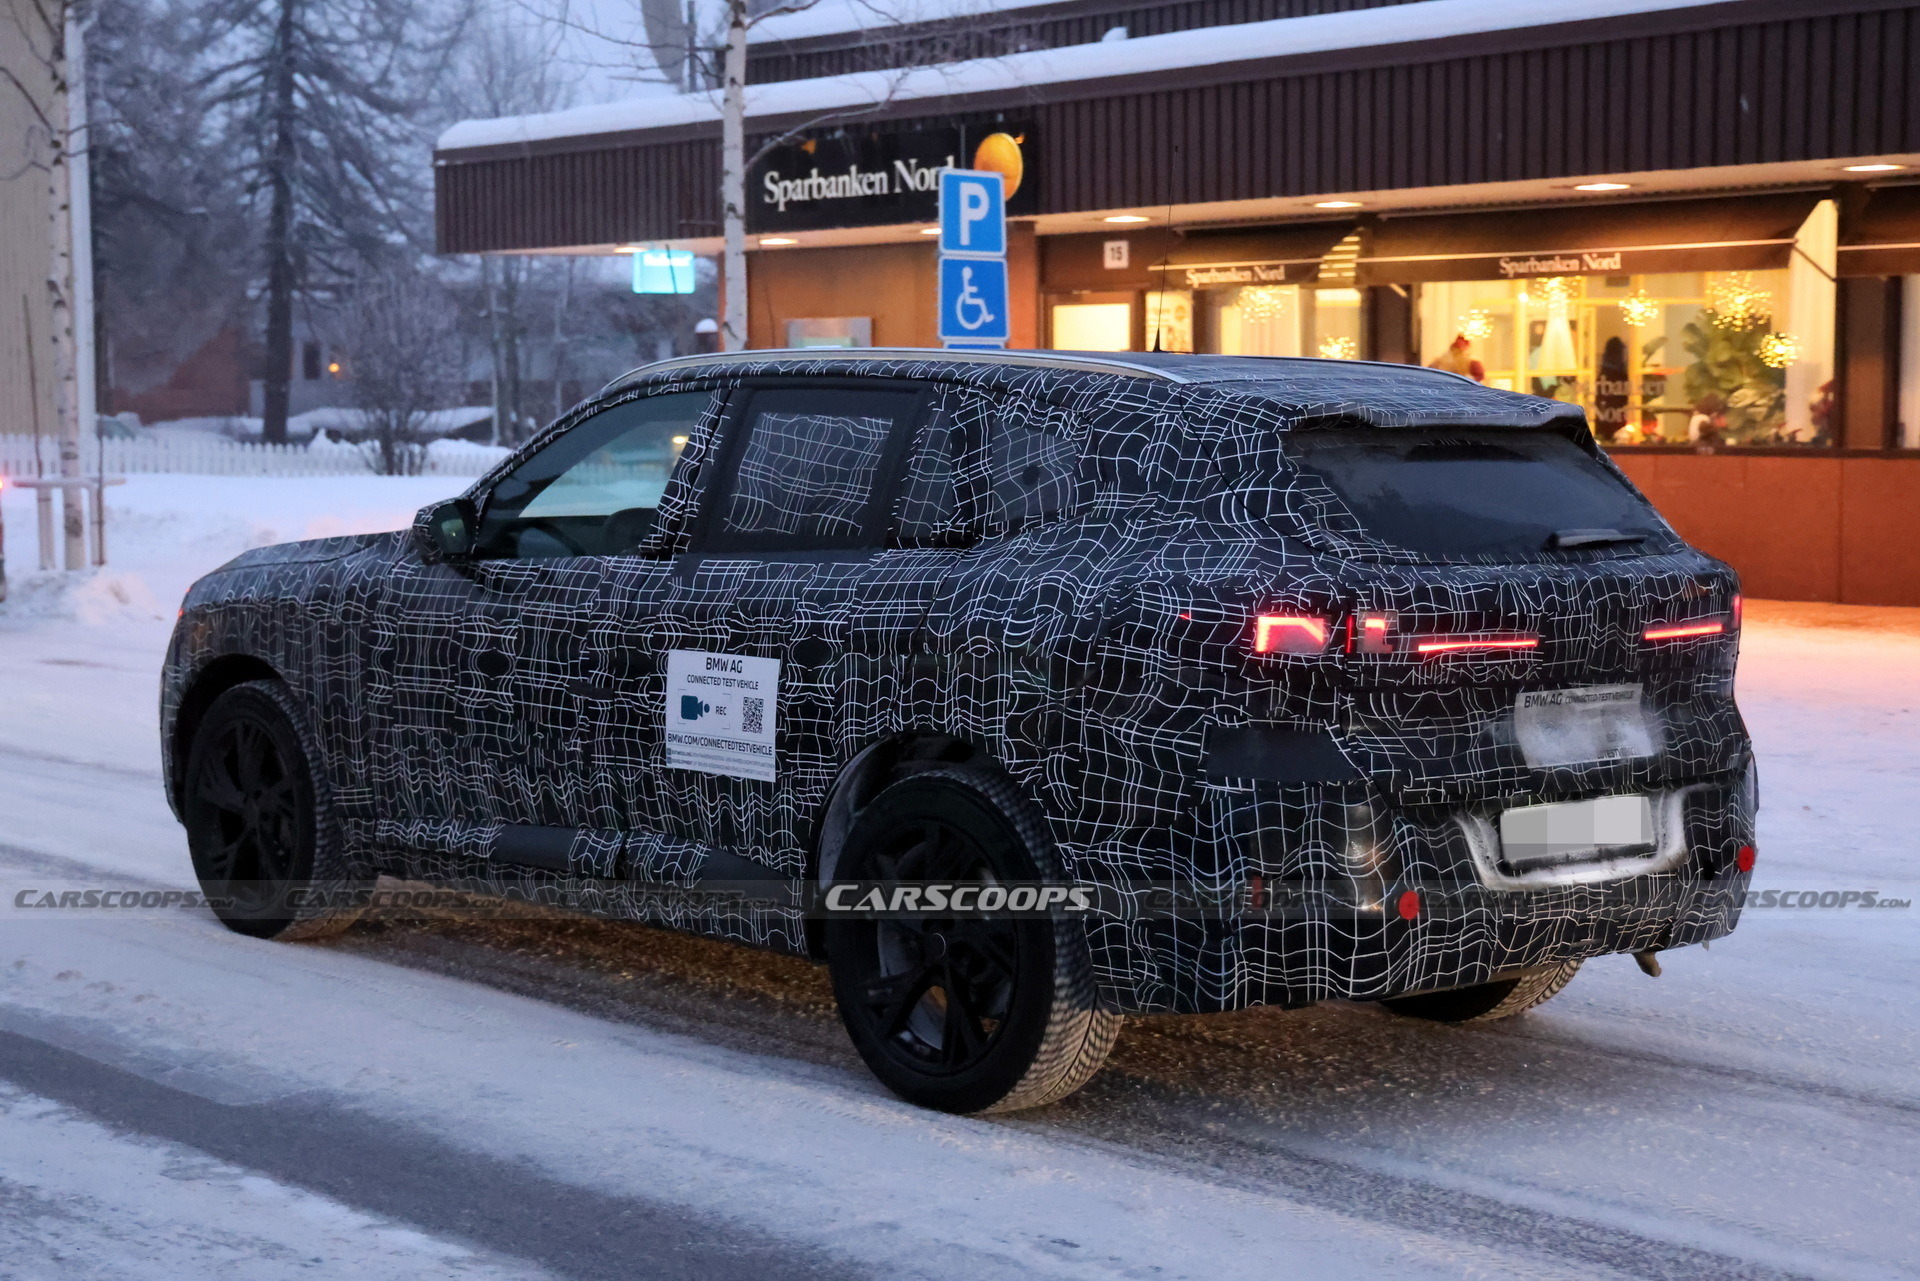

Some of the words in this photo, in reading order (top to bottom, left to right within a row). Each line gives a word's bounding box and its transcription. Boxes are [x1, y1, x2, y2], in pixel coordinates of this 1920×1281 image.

[763, 164, 889, 212] Sparbanken
[959, 182, 990, 246] P
[1110, 246, 1123, 261] 15
[1499, 255, 1580, 278] Sparbanken
[1582, 252, 1622, 271] Nord
[1185, 267, 1253, 288] Sparbanken
[1254, 264, 1286, 282] Nord
[705, 657, 729, 672] BMW
[730, 660, 743, 674] AG
[687, 674, 722, 687] CONNECTED
[722, 678, 737, 688] TEST
[737, 680, 759, 691] VEHICLE
[1524, 694, 1548, 708] BMW
[1549, 692, 1563, 706] AG
[715, 705, 727, 716] REC
[667, 733, 773, 756] BMW.COM/CONNECTEDTESTVEHICLE
